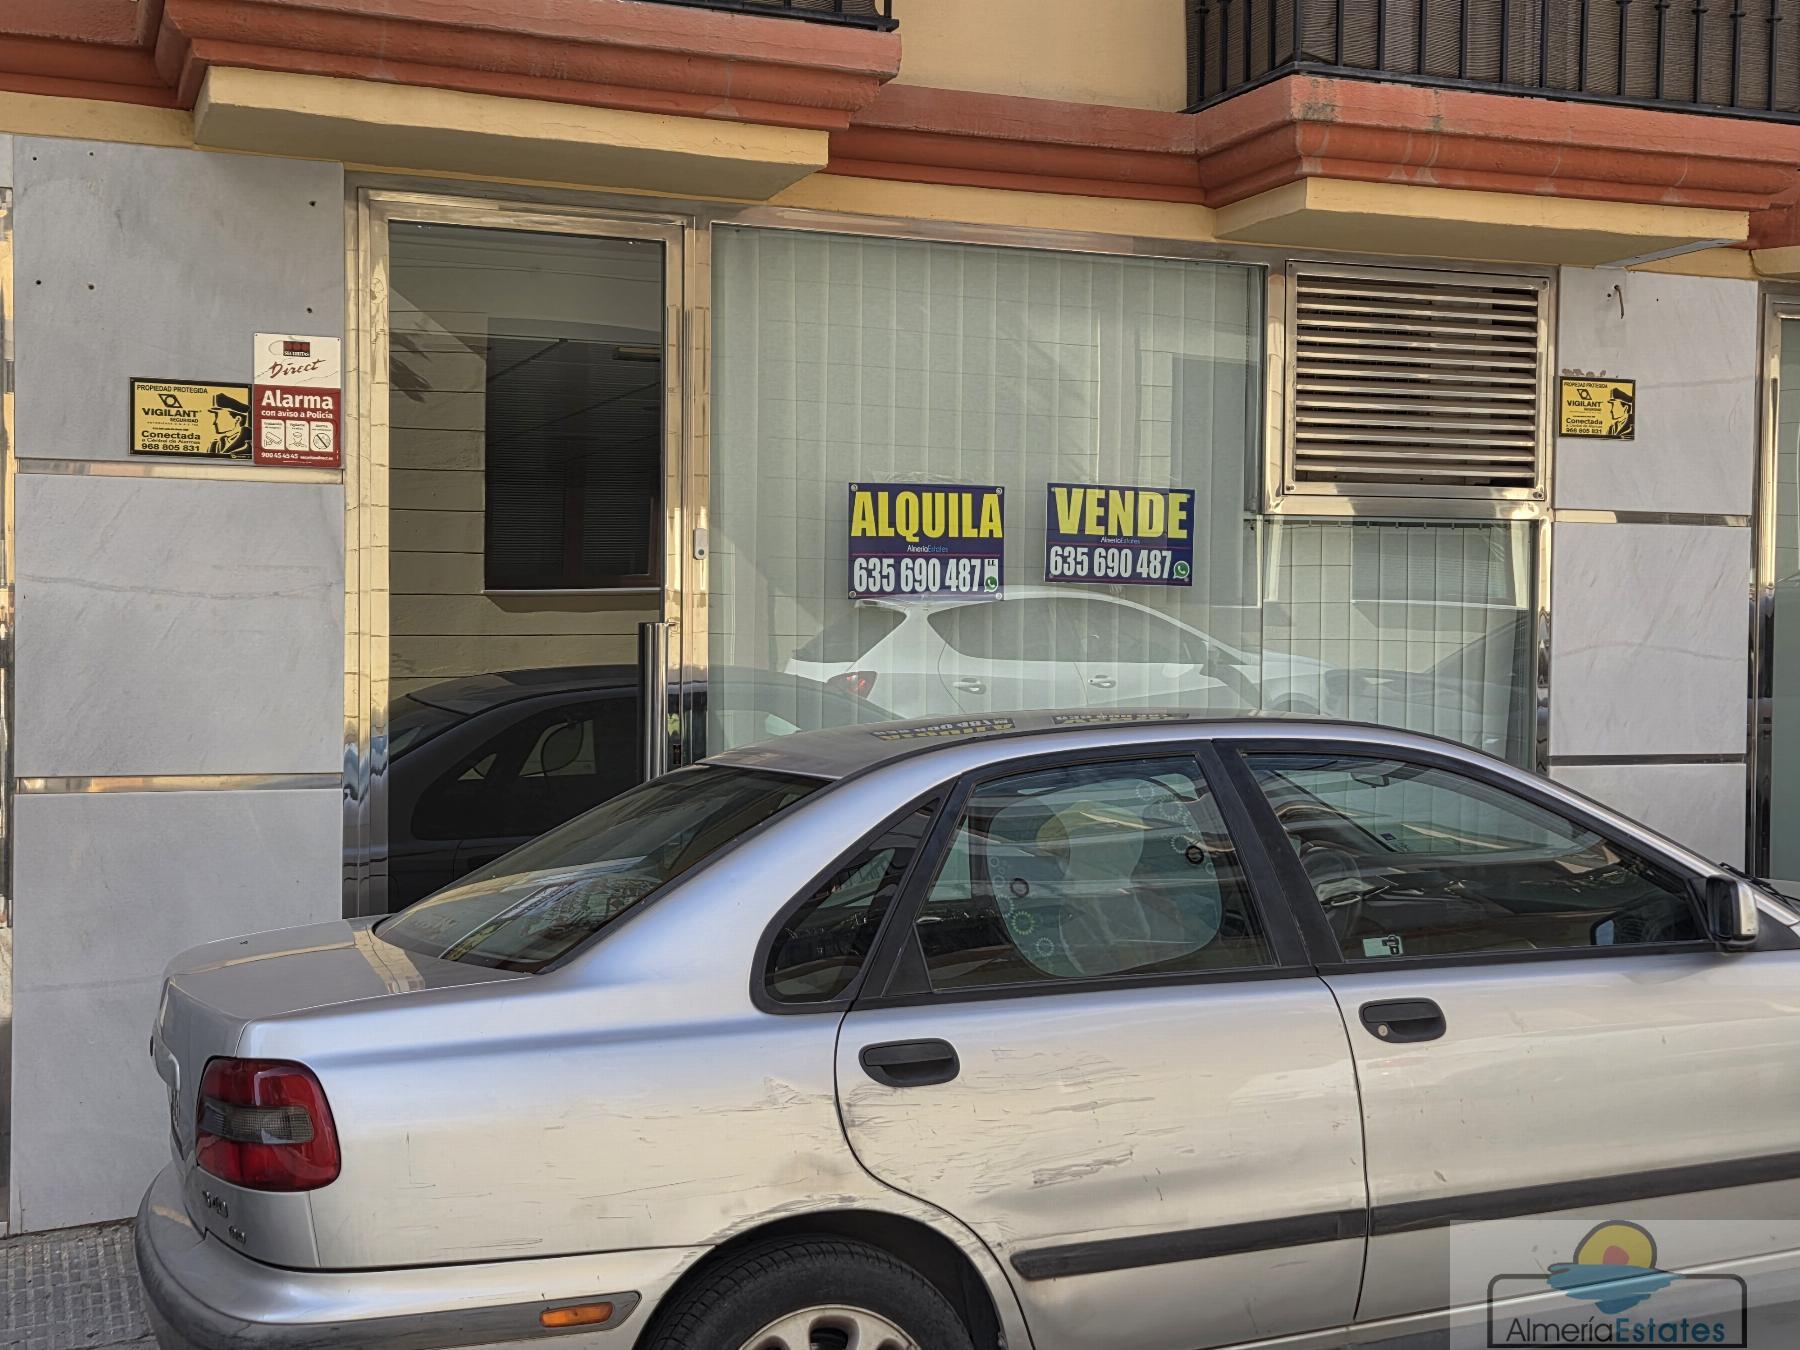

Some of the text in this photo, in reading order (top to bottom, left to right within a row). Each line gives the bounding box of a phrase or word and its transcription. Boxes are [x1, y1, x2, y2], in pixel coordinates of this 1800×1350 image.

[269, 359, 327, 379] Direct
[136, 384, 208, 394] PROPIEDAD PROTEGIDA
[261, 389, 333, 410] Alarma
[1567, 400, 1601, 408] VIGILANT
[142, 408, 199, 418] VIGILANT
[277, 409, 299, 418] aviso
[307, 410, 333, 419] Policía
[141, 430, 200, 440] Conectada
[851, 490, 1003, 543] ALQUILA
[1055, 487, 1188, 539] VENDE
[1049, 546, 1172, 579] 635 690 487
[853, 557, 981, 593] 635 690 487
